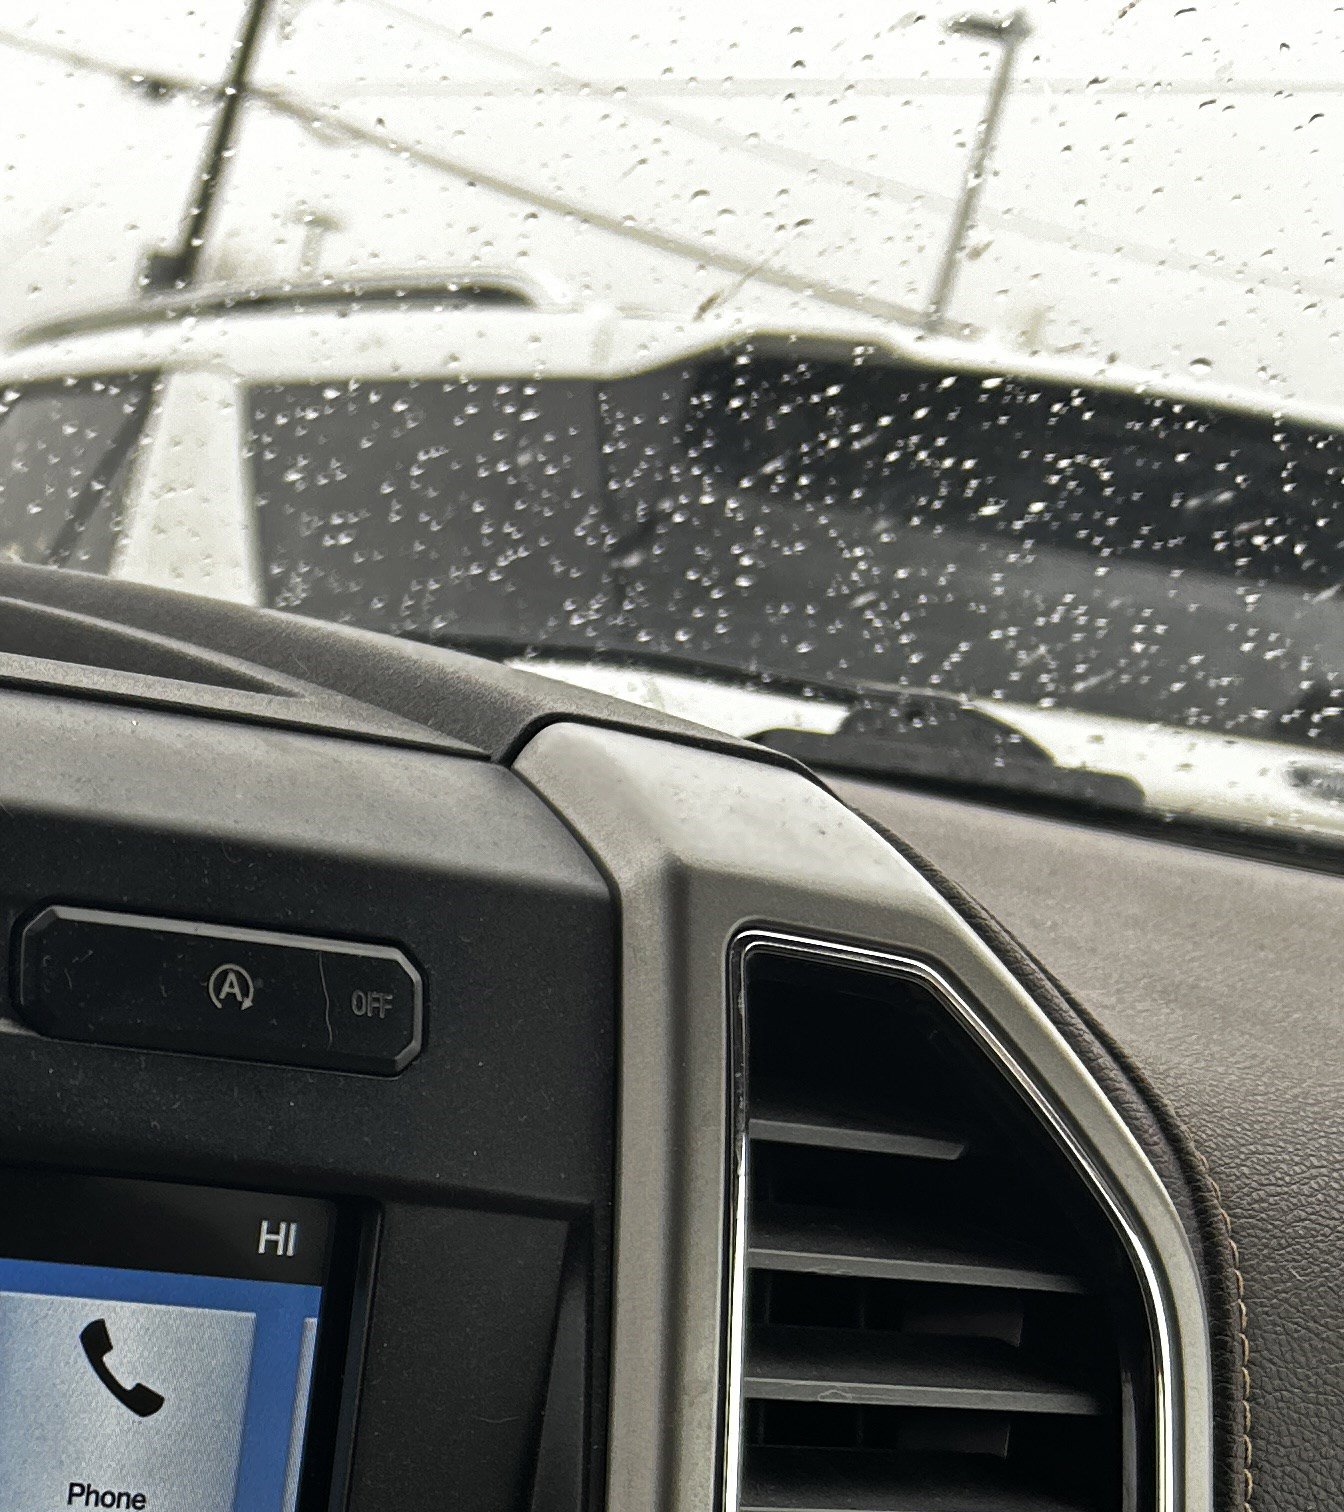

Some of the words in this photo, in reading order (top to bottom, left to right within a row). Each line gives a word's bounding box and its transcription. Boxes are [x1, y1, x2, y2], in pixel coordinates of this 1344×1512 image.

[218, 970, 243, 1002] A
[351, 989, 393, 1019] OFF
[258, 1220, 297, 1257] HI
[67, 1482, 147, 1511] Phone
